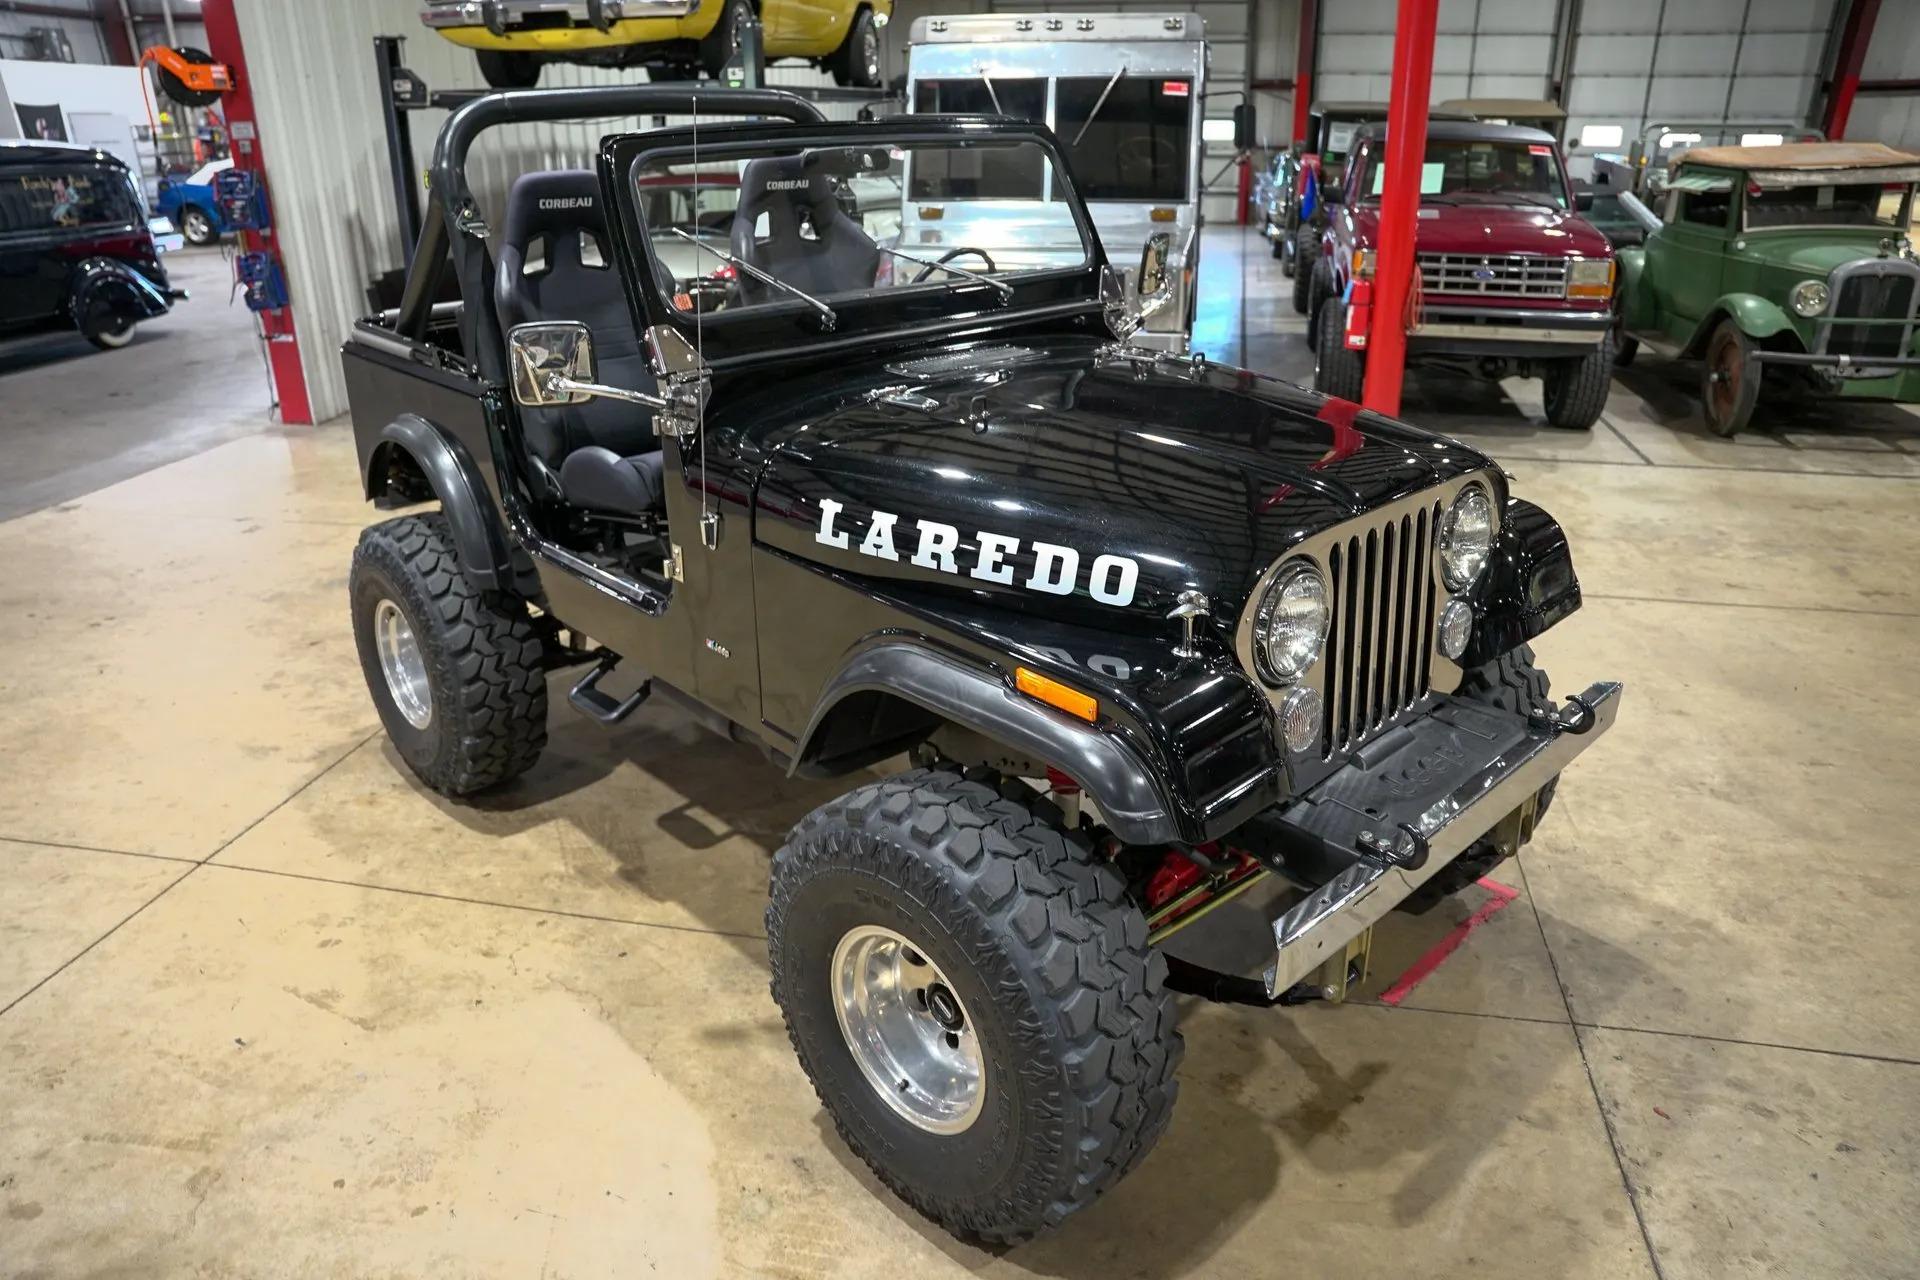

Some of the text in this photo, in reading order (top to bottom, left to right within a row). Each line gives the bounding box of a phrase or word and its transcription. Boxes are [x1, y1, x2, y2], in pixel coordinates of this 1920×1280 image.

[766, 179, 809, 190] CORBEAU
[539, 196, 593, 210] CORBEAU
[815, 498, 1139, 607] LAREDO
